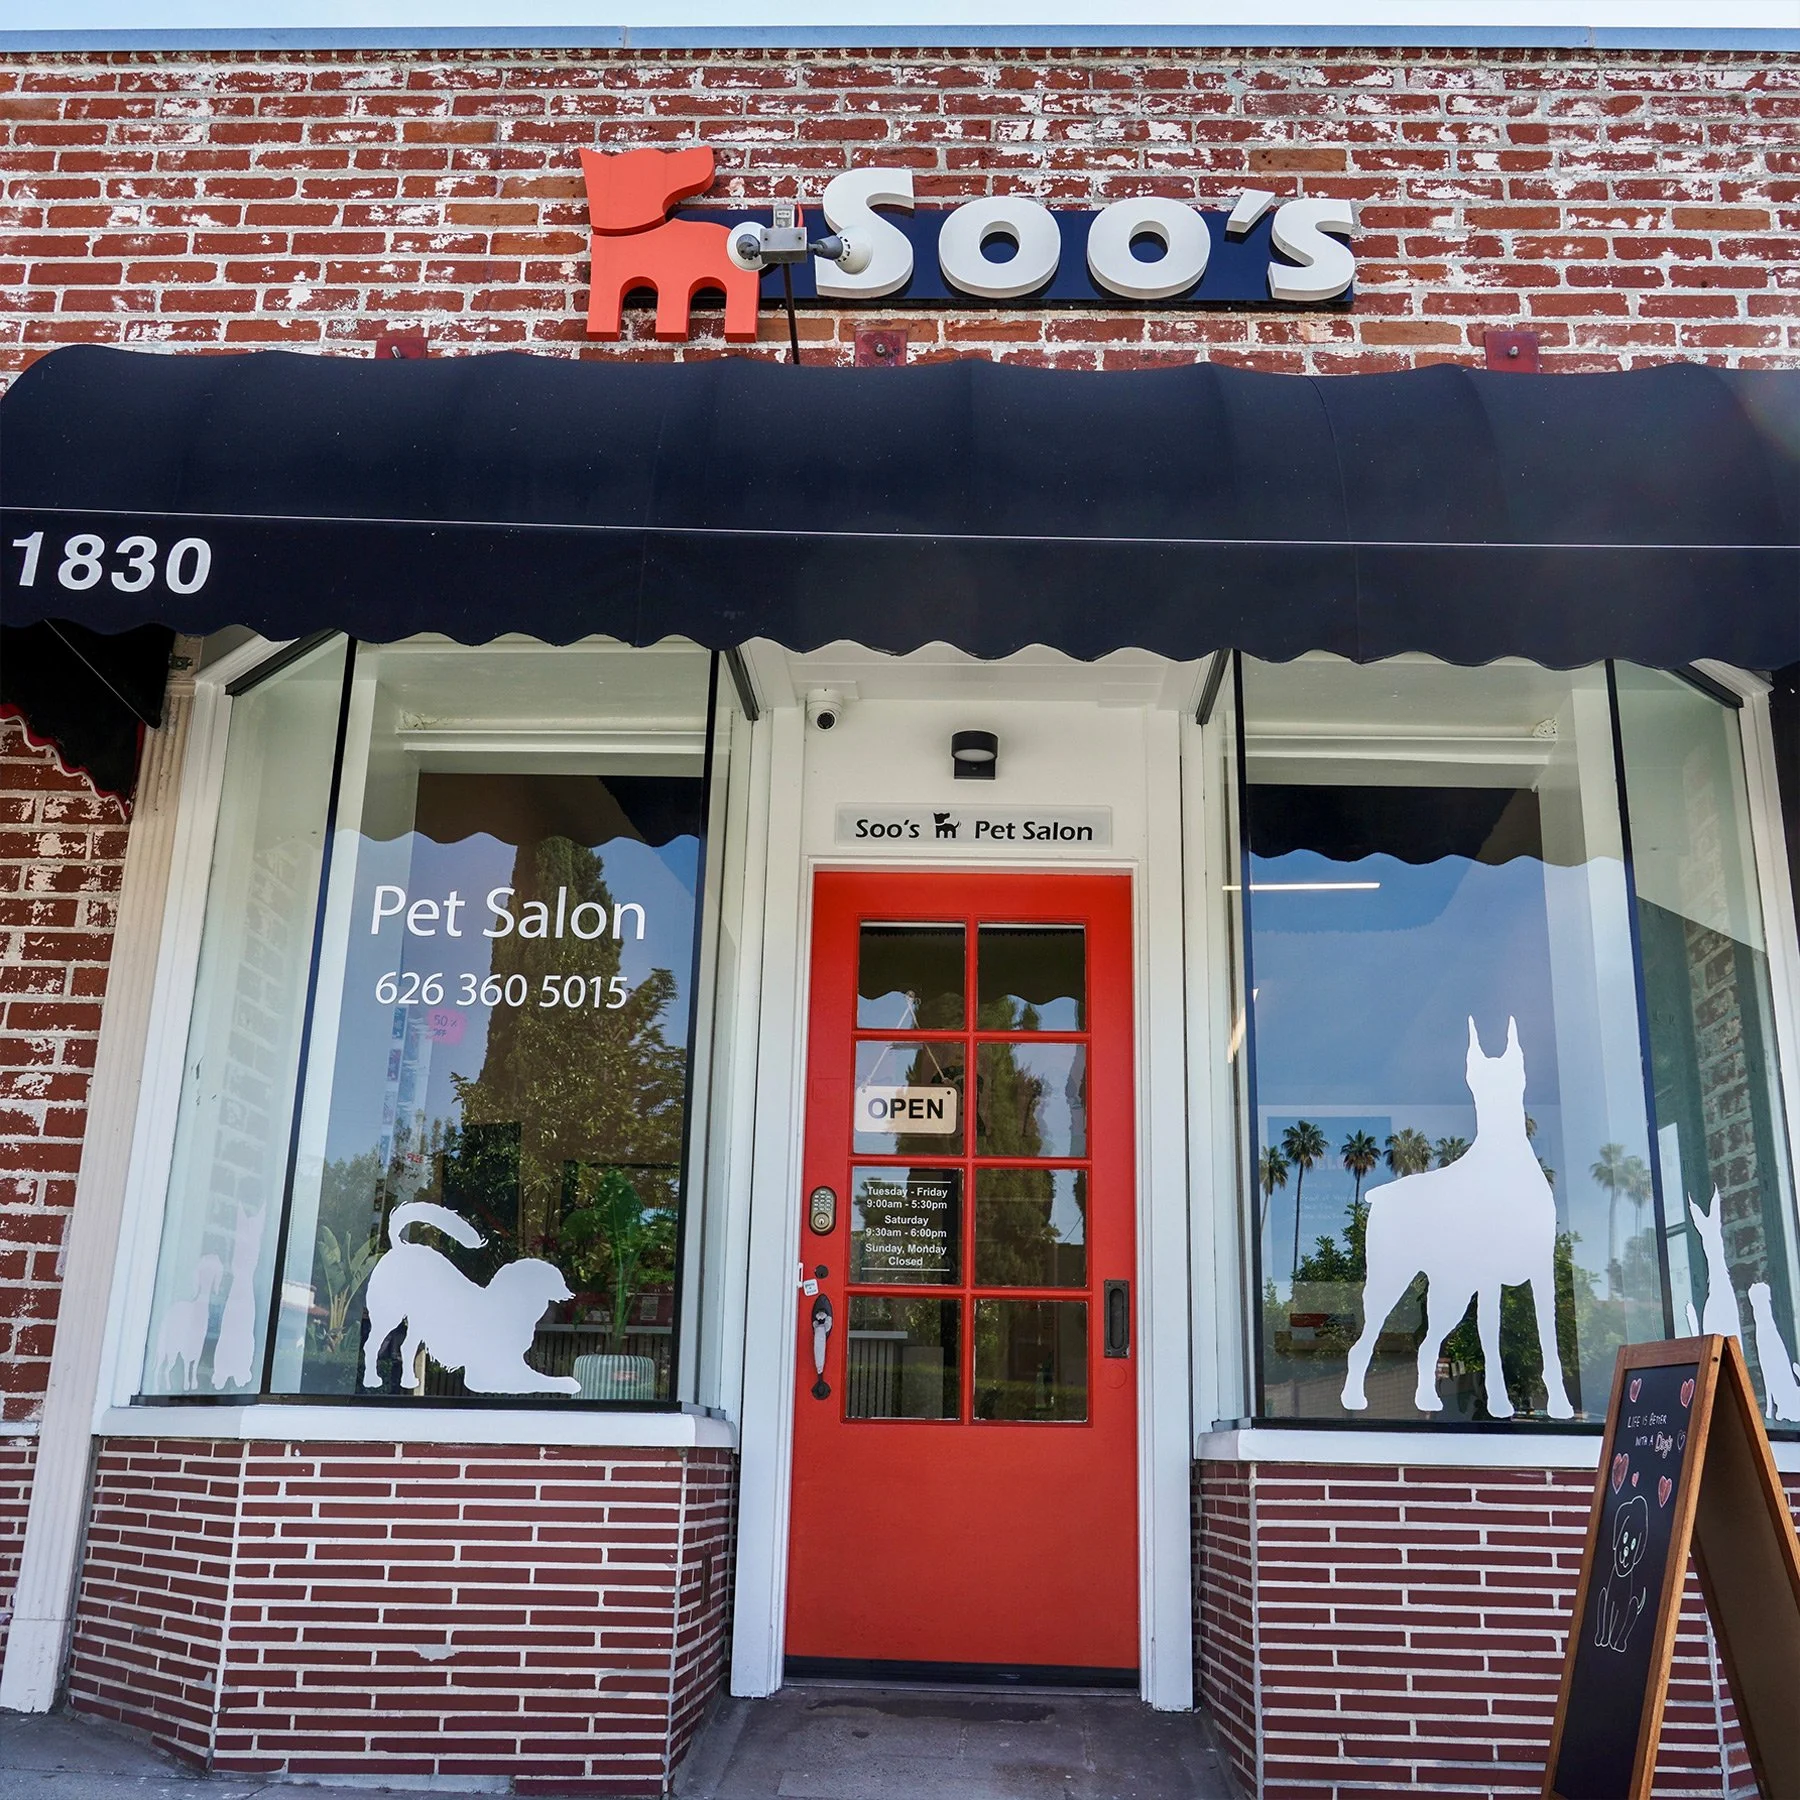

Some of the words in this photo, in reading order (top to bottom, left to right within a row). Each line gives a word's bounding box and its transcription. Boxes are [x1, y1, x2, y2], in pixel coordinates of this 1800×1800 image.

[815, 167, 1357, 300] Soo's
[12, 531, 212, 595] 1830
[855, 819, 920, 839] Soo's
[974, 820, 1016, 840] Pet
[1022, 821, 1093, 841] Salon
[370, 885, 465, 938] Pet
[482, 886, 647, 940] Salon
[375, 971, 444, 1005] 626
[455, 973, 528, 1007] 360
[538, 975, 629, 1009] 5015
[867, 1097, 944, 1119] OPEN
[867, 1186, 908, 1198] Tuesday
[917, 1187, 948, 1198] Friday
[866, 1199, 902, 1209] 9:00am
[911, 1200, 948, 1211] 5:30pm
[884, 1215, 929, 1226] Saturday
[865, 1227, 902, 1237] 9:30am
[910, 1228, 947, 1239] 6:00pm
[865, 1243, 905, 1255] Sunday,
[907, 1244, 947, 1256] Monday
[888, 1256, 923, 1266] Closed
[1627, 1416, 1641, 1428] LIFE
[1642, 1415, 1648, 1426] IS
